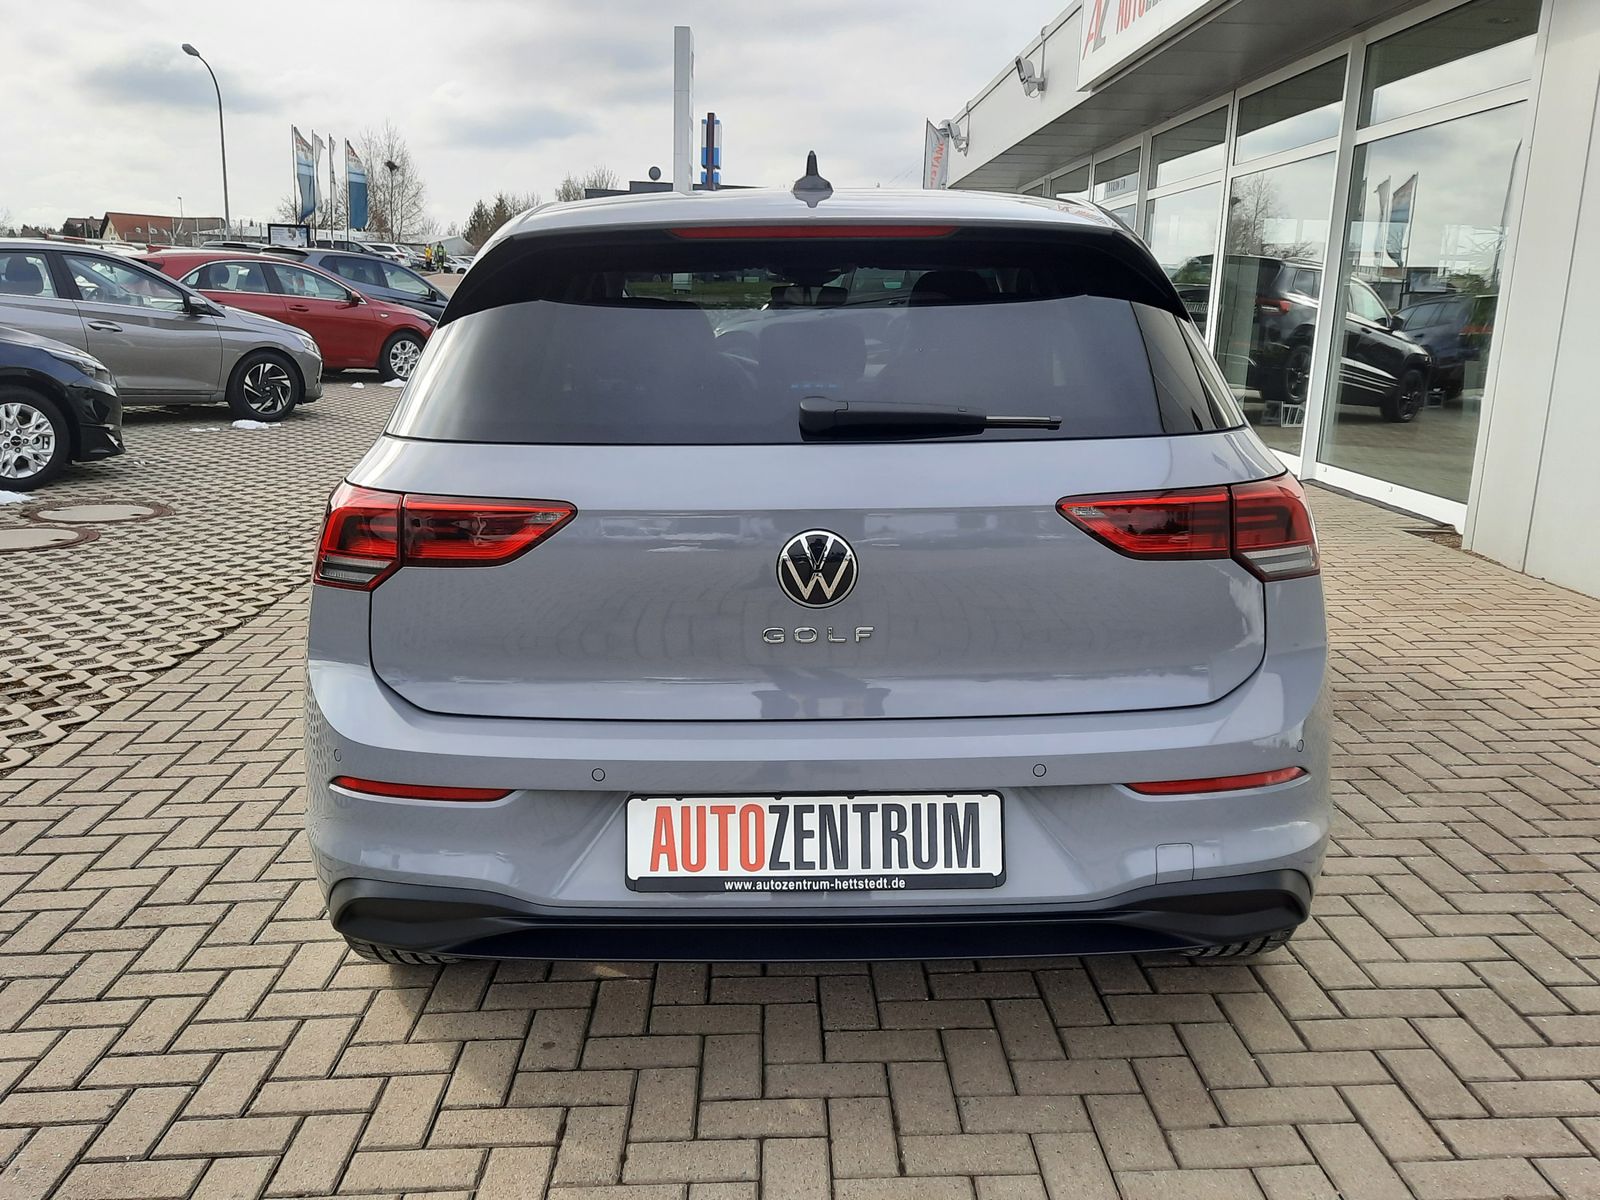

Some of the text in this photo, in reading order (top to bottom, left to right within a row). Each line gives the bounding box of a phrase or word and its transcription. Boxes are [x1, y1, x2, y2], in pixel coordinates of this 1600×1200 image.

[763, 627, 874, 643] GOLF
[649, 803, 981, 872] AUTOZENTRUM
[724, 877, 906, 890] www.autozentrum-hettstedt.de
